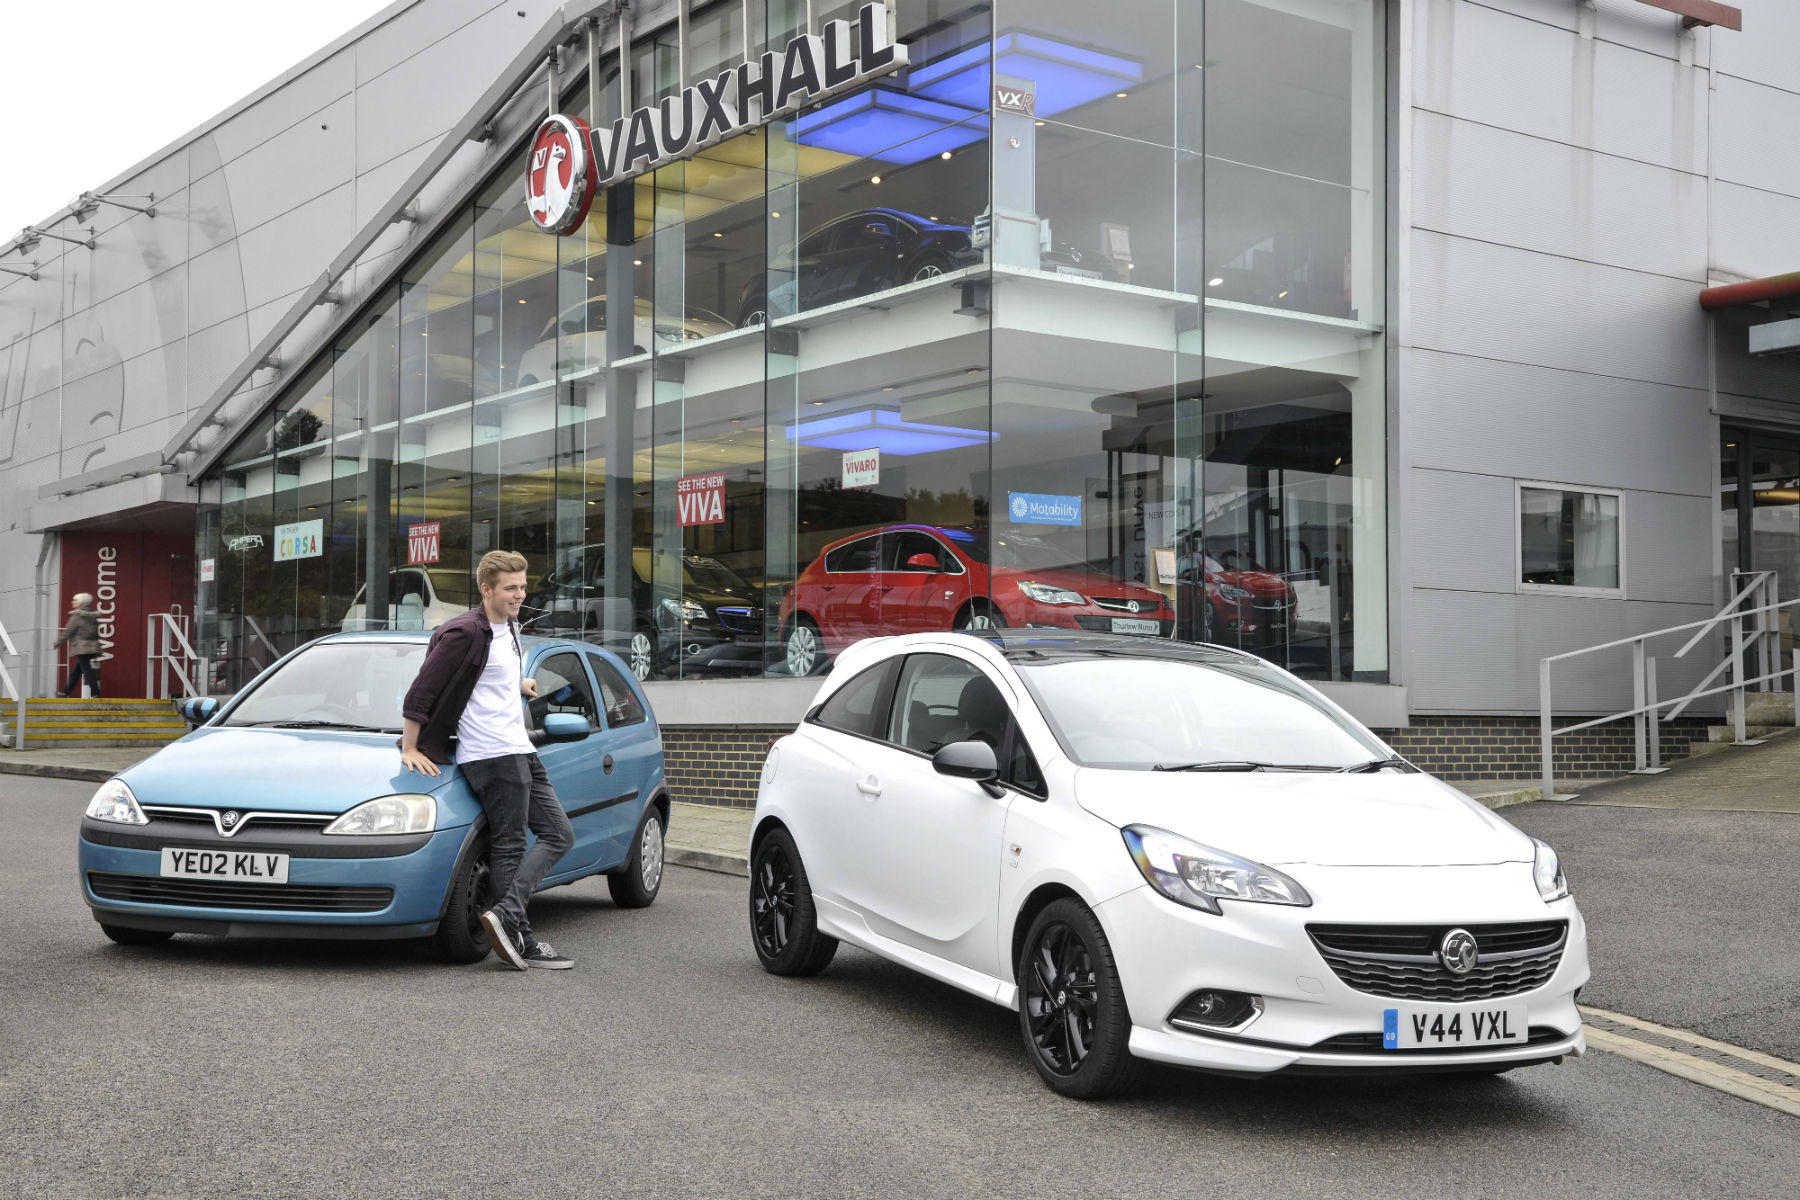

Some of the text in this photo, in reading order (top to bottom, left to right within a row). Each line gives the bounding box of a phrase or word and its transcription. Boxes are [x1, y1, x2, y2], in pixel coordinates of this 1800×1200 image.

[590, 2, 899, 184] VAUXHALL
[997, 91, 1035, 117] VXR
[846, 459, 877, 475] VIVARO
[678, 475, 724, 491] SEE THE NEW
[678, 489, 724, 524] VIVA
[1030, 503, 1079, 520] Motability
[228, 534, 264, 551] AMPERA
[409, 523, 439, 537] SEE THE NEW
[281, 534, 317, 558] CORSA
[409, 535, 439, 563] VIVA
[97, 546, 117, 663] welcome
[172, 851, 279, 877] YE02 KLV
[1412, 1010, 1517, 1043] V44 VXL
